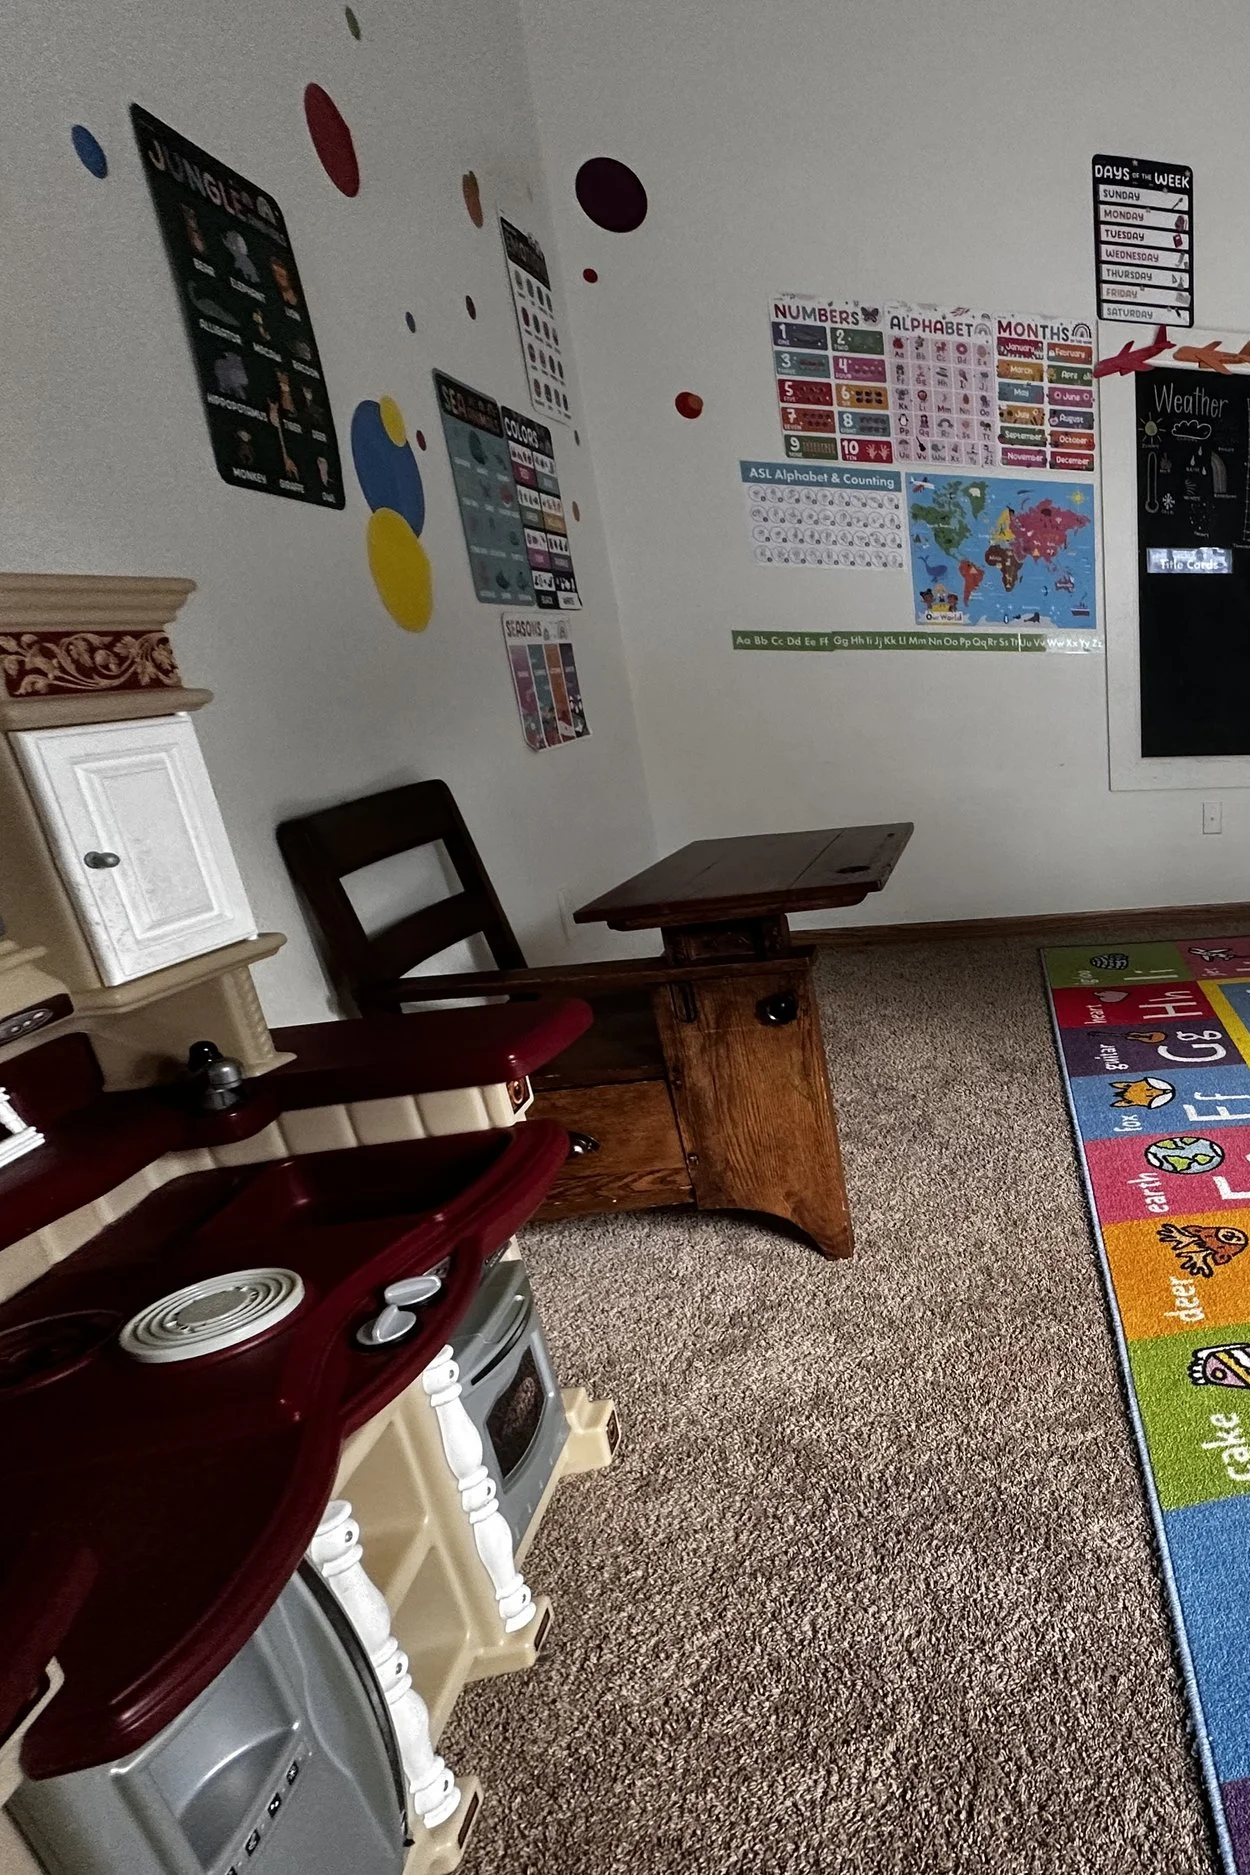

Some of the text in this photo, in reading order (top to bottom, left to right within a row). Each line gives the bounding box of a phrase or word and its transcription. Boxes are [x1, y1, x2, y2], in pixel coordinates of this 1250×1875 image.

[1095, 165, 1130, 181] DAYS
[1154, 172, 1190, 189] WEEK
[1103, 189, 1140, 201] SUNDAY
[1104, 209, 1144, 222] MONDAY
[1105, 229, 1145, 242] TUESDAY
[1105, 249, 1159, 263] WEDNESDAY
[1106, 268, 1152, 281] THURSDAY
[1106, 287, 1138, 299] FRIDAY
[773, 303, 860, 326] NUMBERS
[1107, 307, 1153, 320] SATURDAY
[779, 323, 786, 339] 1
[890, 314, 974, 338] ALPHABET
[997, 319, 1070, 342] MONTHS
[836, 329, 845, 345] 2
[780, 353, 791, 368] 3
[1055, 348, 1085, 359] February
[838, 358, 848, 373] 4
[1010, 365, 1033, 375] March
[784, 381, 794, 397] 5
[840, 385, 850, 400] 6
[1062, 392, 1081, 401] June
[1154, 382, 1229, 418] Weather
[786, 408, 796, 423] 7
[842, 413, 853, 428] 8
[1059, 413, 1084, 424] August
[505, 417, 539, 448] COLORS
[1004, 430, 1042, 443] September
[1059, 435, 1088, 445] October
[790, 437, 800, 451] 9
[841, 440, 859, 455] 10
[1007, 452, 1044, 462] November
[1056, 455, 1090, 465] December
[749, 467, 895, 490] ASL Alphabet & Counting
[1160, 558, 1219, 570] Title Cards
[940, 613, 962, 621] World
[505, 620, 542, 638] SEASONS
[736, 636, 988, 649] Aa Bb Cc Gg Jj Kk Pp Qq
[1084, 1005, 1107, 1025] heart
[1095, 1043, 1130, 1071] guitar
[1113, 1113, 1143, 1133] fox
[1127, 1170, 1171, 1214] earth
[1163, 1274, 1208, 1324] deer
